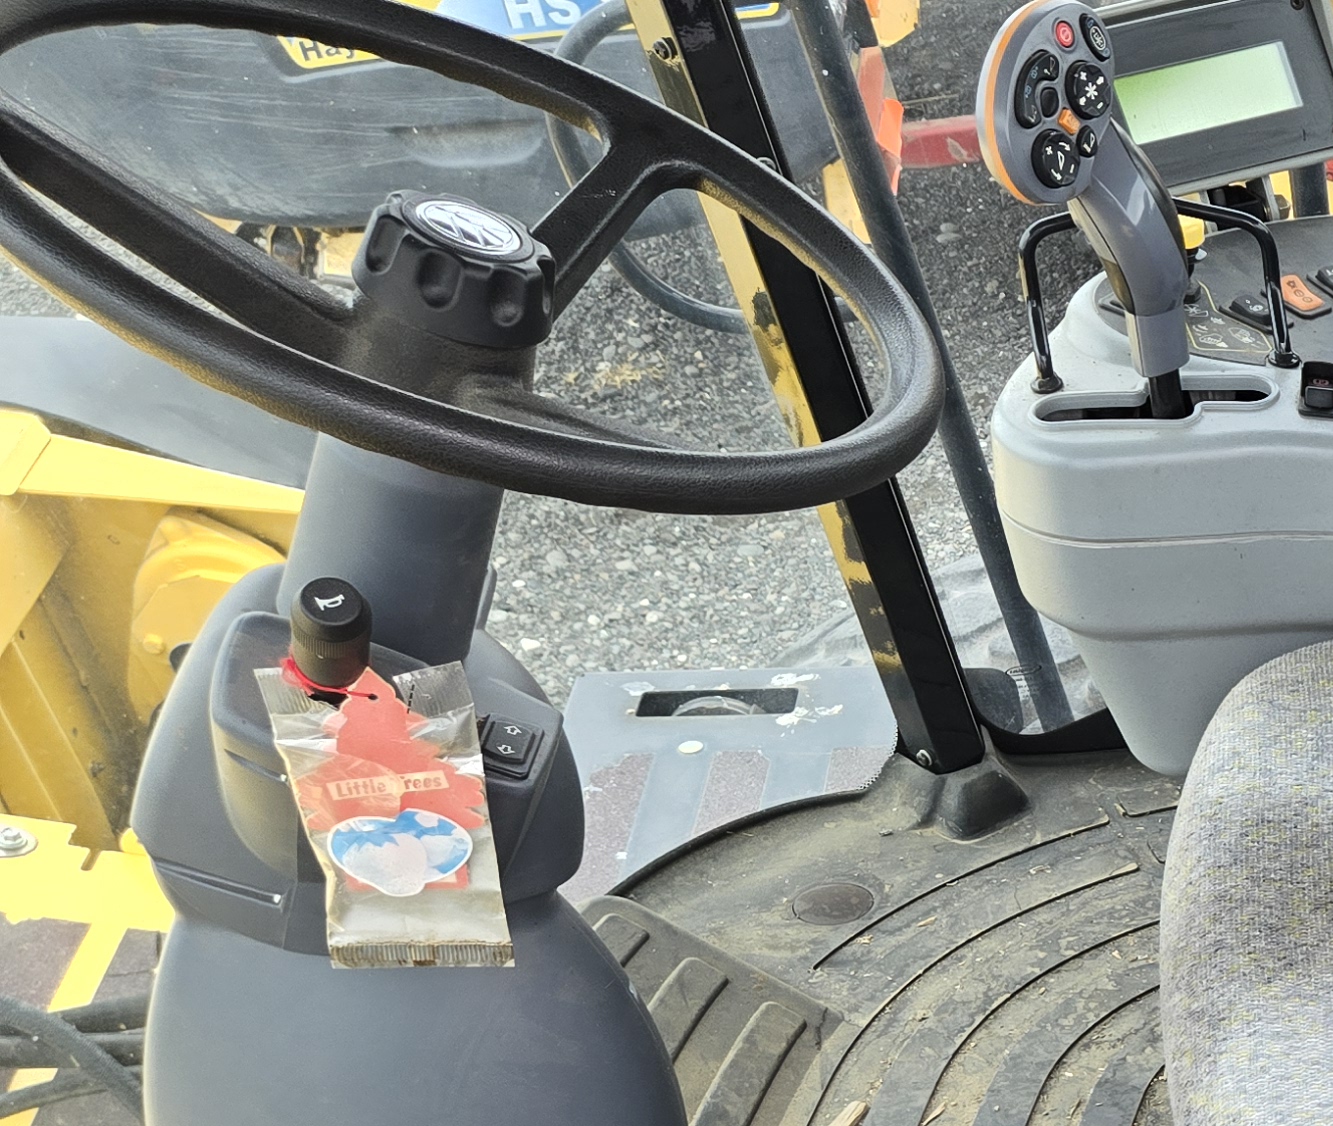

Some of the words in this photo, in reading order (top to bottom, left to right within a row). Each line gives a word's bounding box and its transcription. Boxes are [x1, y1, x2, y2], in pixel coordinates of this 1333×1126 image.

[504, 0, 582, 29] HS
[335, 778, 387, 798] Little
[399, 775, 442, 790] rees
